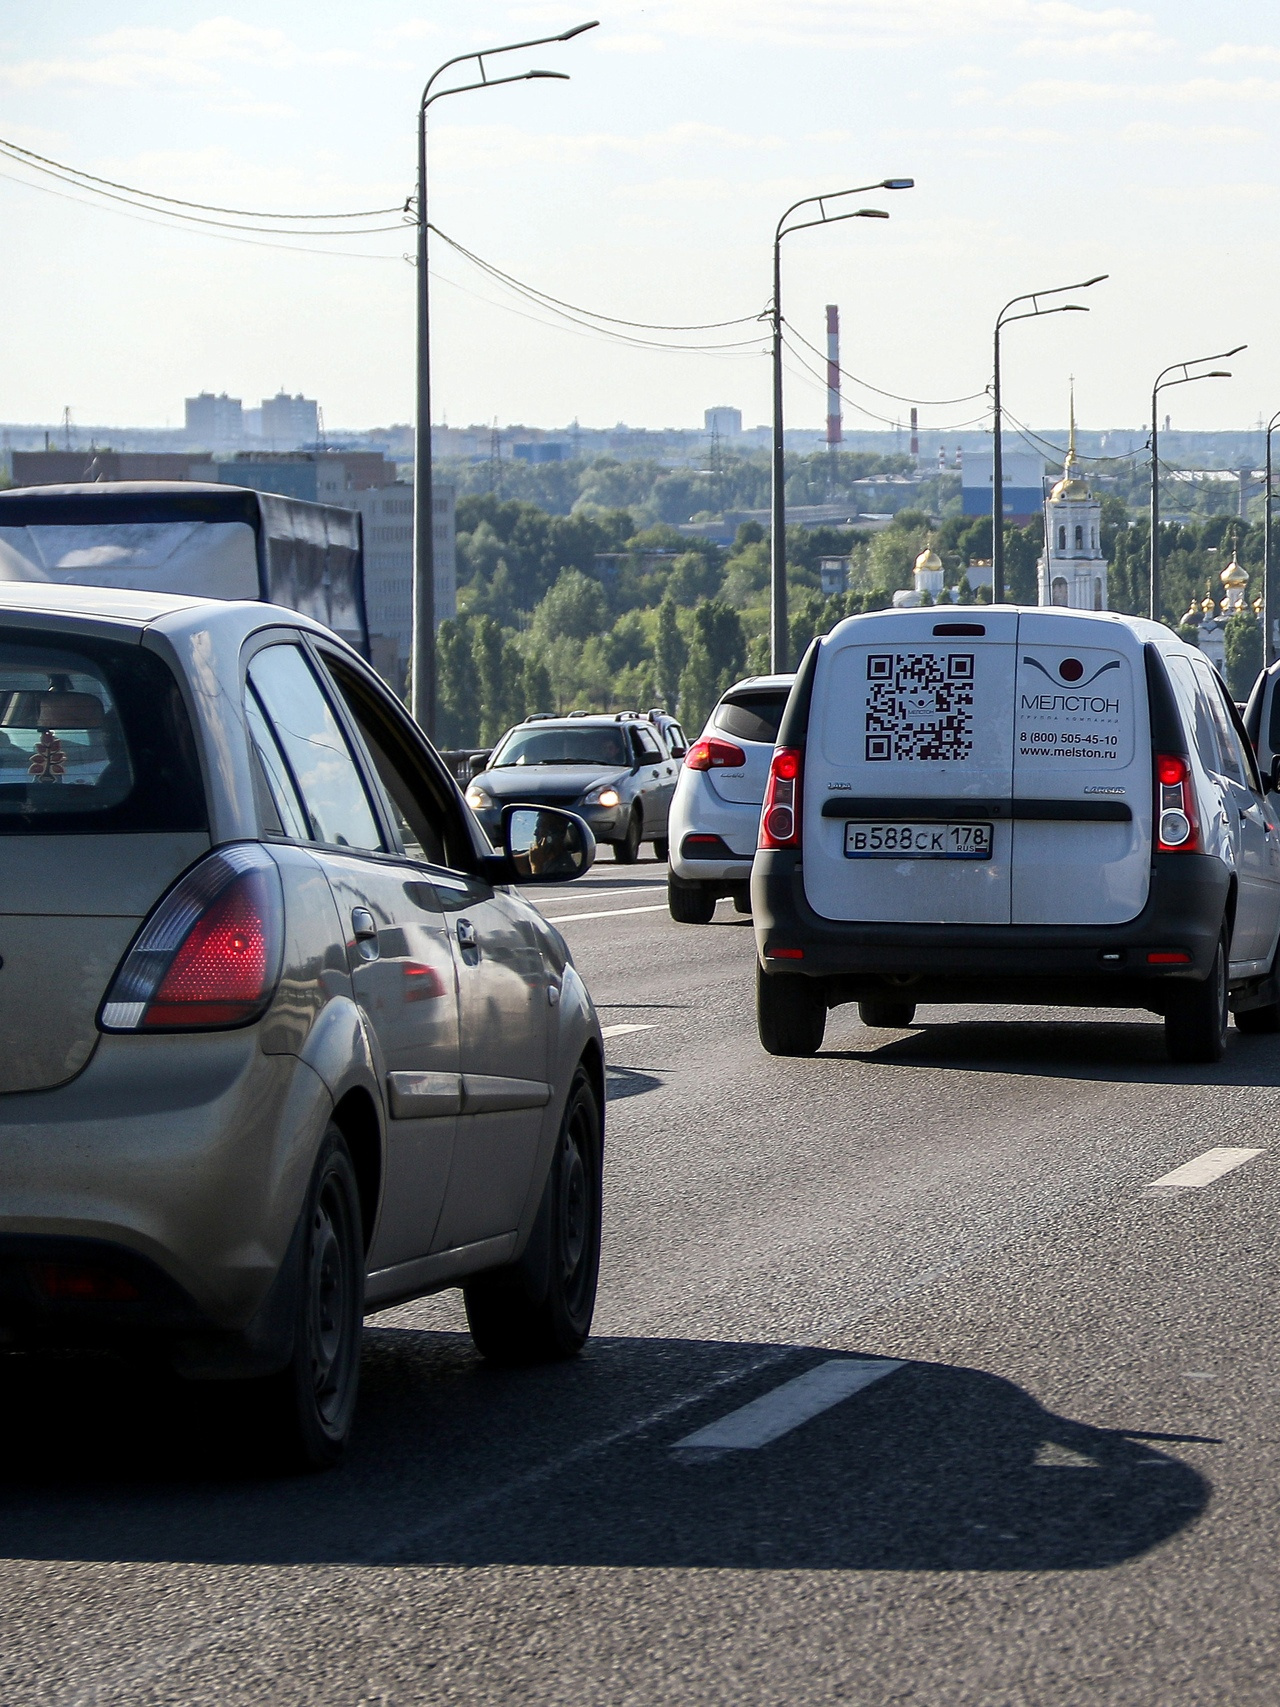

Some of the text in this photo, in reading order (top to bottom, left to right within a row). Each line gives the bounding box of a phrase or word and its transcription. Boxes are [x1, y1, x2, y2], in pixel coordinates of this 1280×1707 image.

[1021, 695, 1119, 713] МЕЛСТОН
[1020, 732, 1118, 745] 8 (800) 505-45-10
[1020, 746, 1117, 759] www.melston.ru
[1084, 785, 1126, 794] LARGUS
[951, 828, 984, 845] 178
